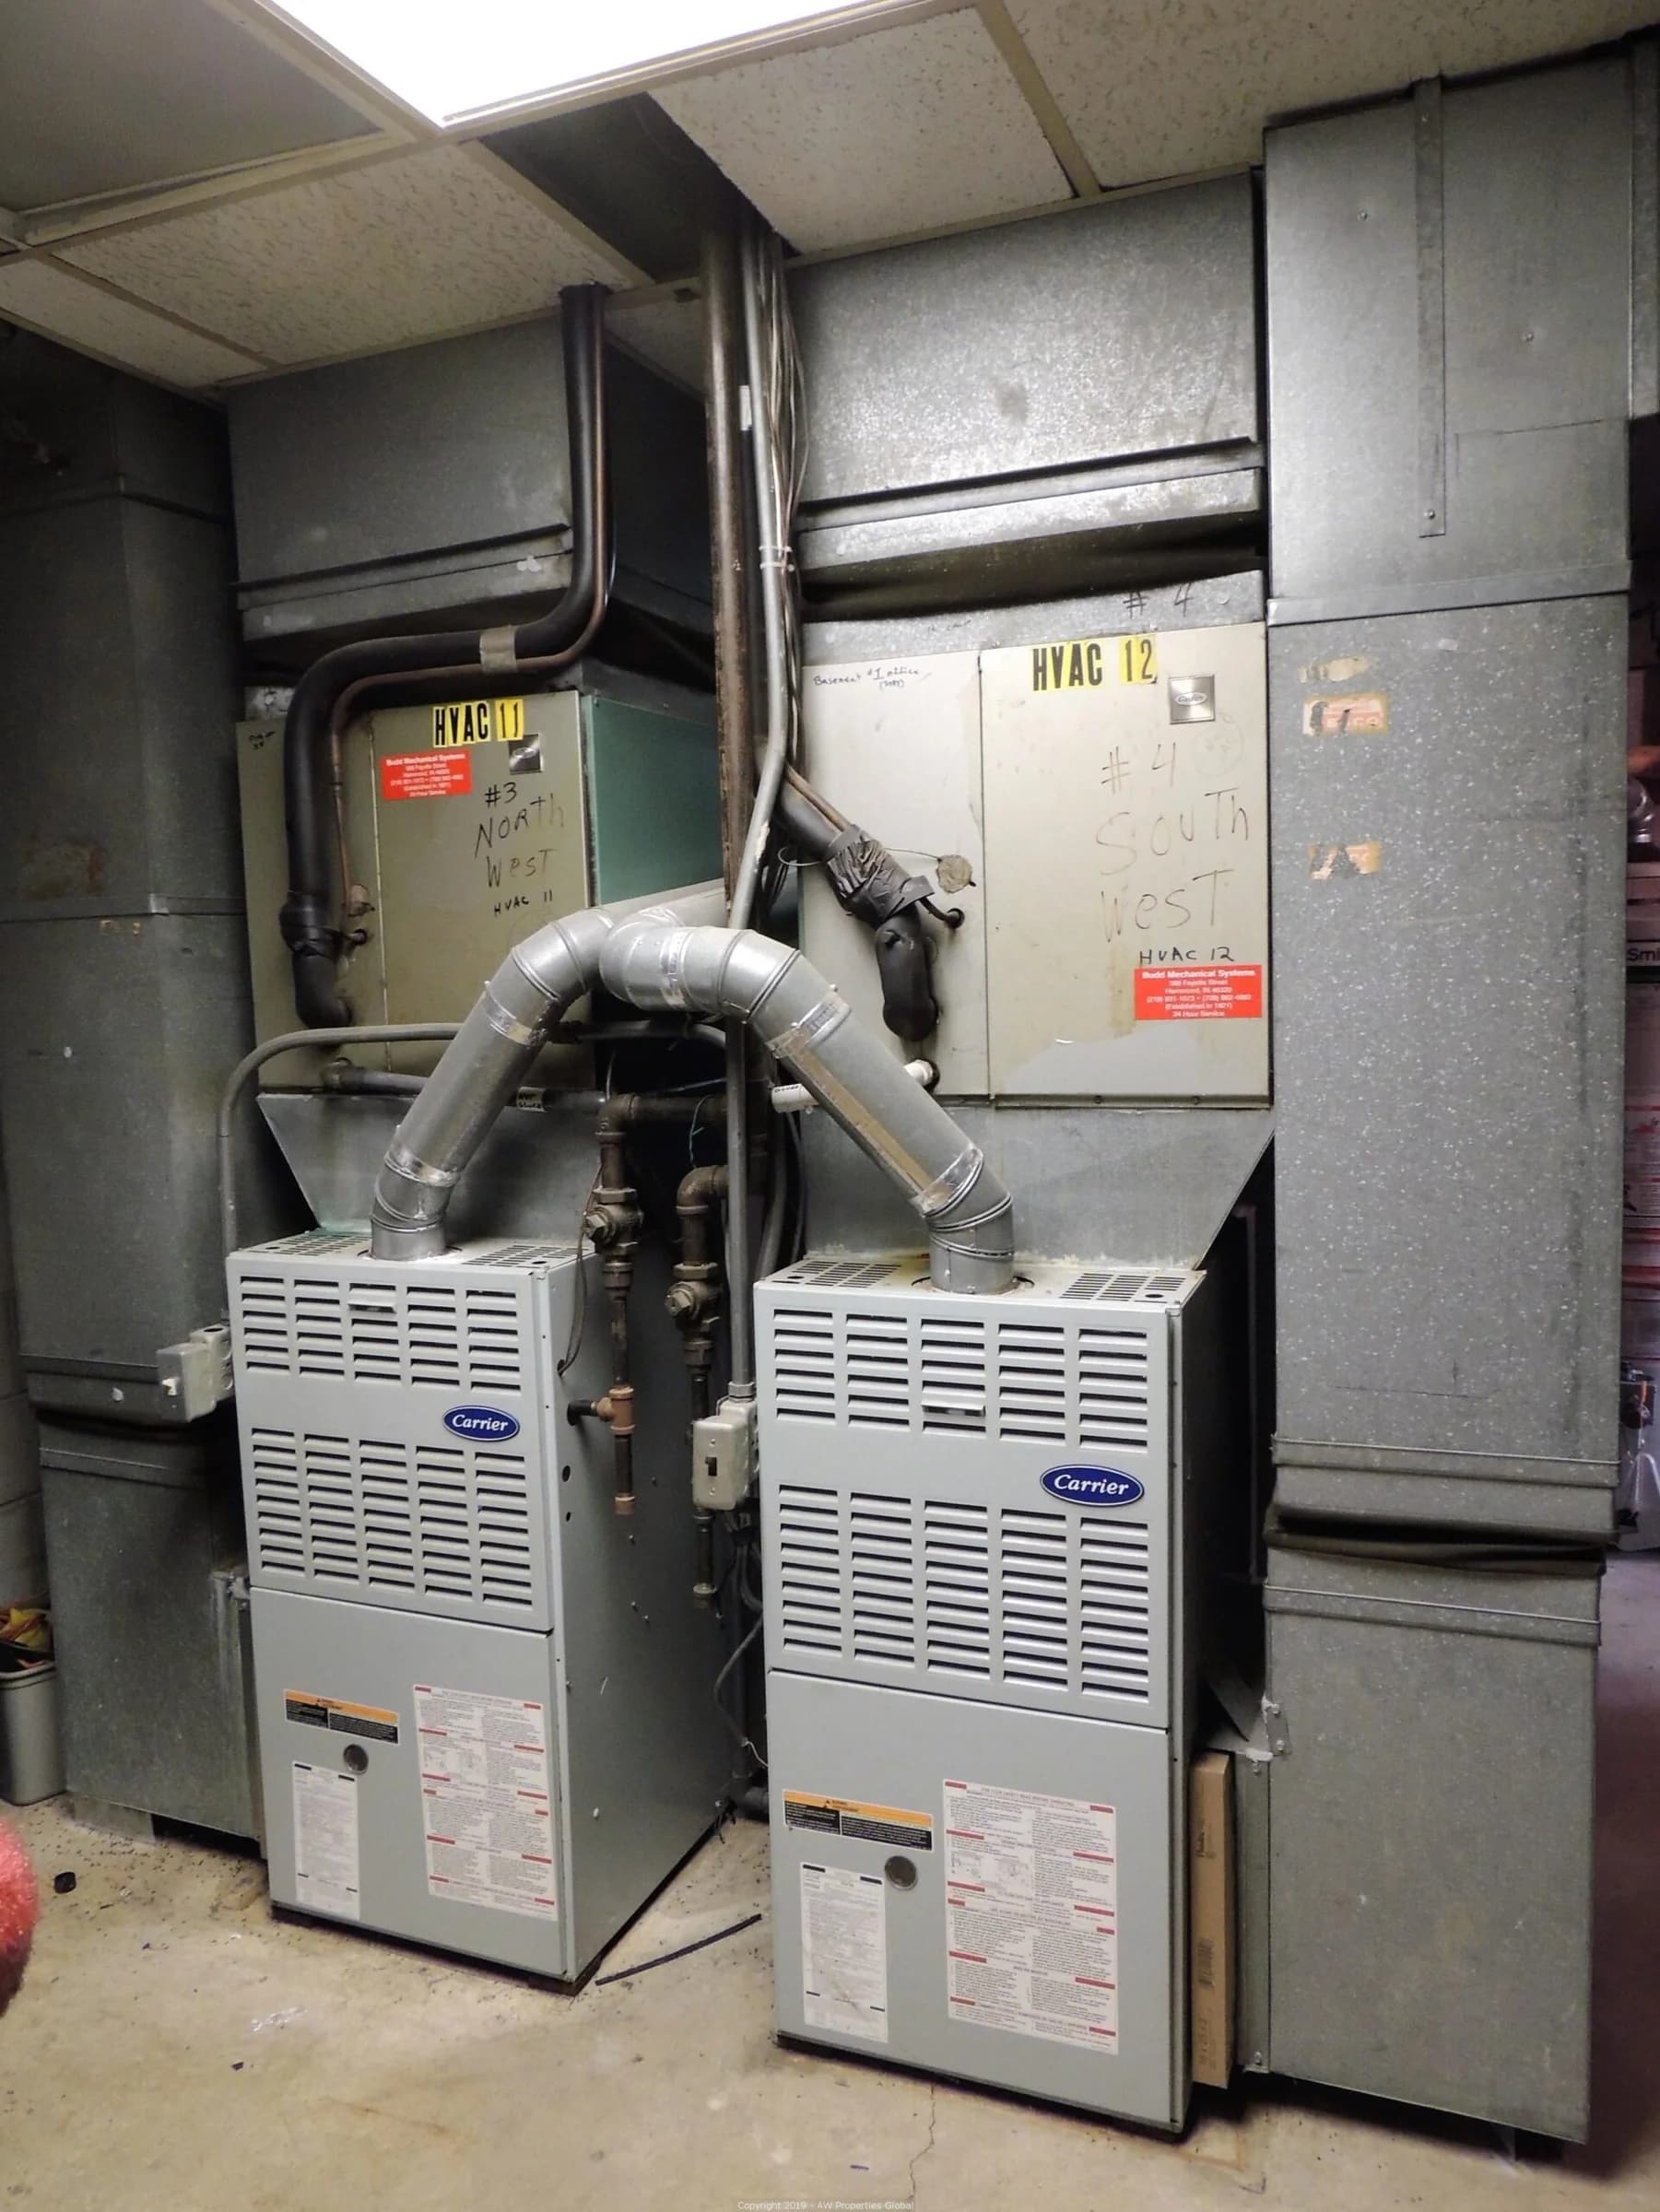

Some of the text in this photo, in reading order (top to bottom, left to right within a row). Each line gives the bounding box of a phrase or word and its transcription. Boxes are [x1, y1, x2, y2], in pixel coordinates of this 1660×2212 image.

[1033, 638, 1153, 691] HVAC 12
[435, 701, 522, 747] HVAC 11
[484, 782, 517, 807] #3
[493, 895, 530, 918] HVAC
[1138, 947, 1235, 967] HVAC 12
[1167, 970, 1217, 979] Mechanical
[1218, 969, 1256, 979] Systems
[452, 1414, 509, 1431] Carrier
[1054, 1474, 1130, 1495] Carrier
